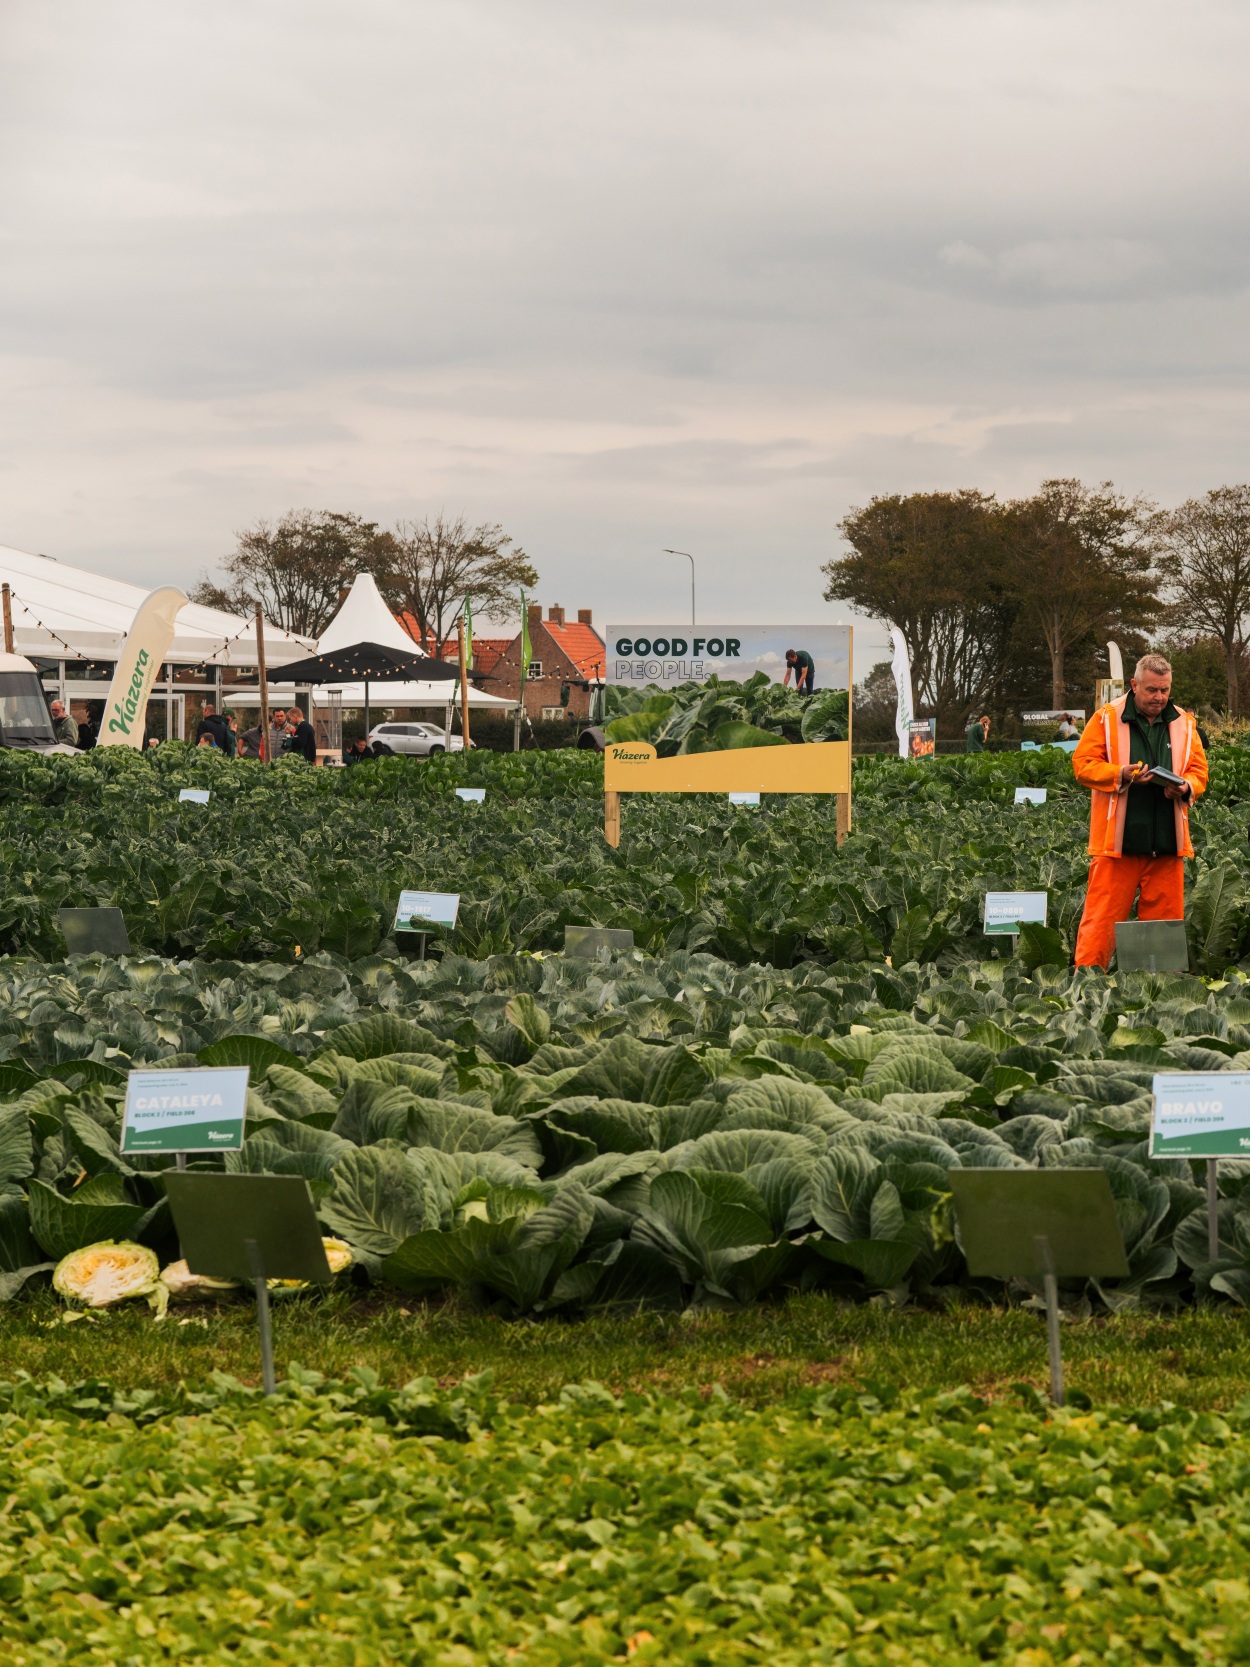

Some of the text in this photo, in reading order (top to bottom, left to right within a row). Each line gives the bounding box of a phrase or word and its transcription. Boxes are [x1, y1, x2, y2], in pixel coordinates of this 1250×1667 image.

[616, 638, 741, 656] GOOD FOR
[616, 660, 712, 679] PEOPLE.
[135, 1093, 223, 1110] CATALEYA
[1161, 1100, 1223, 1115] BRAVO
